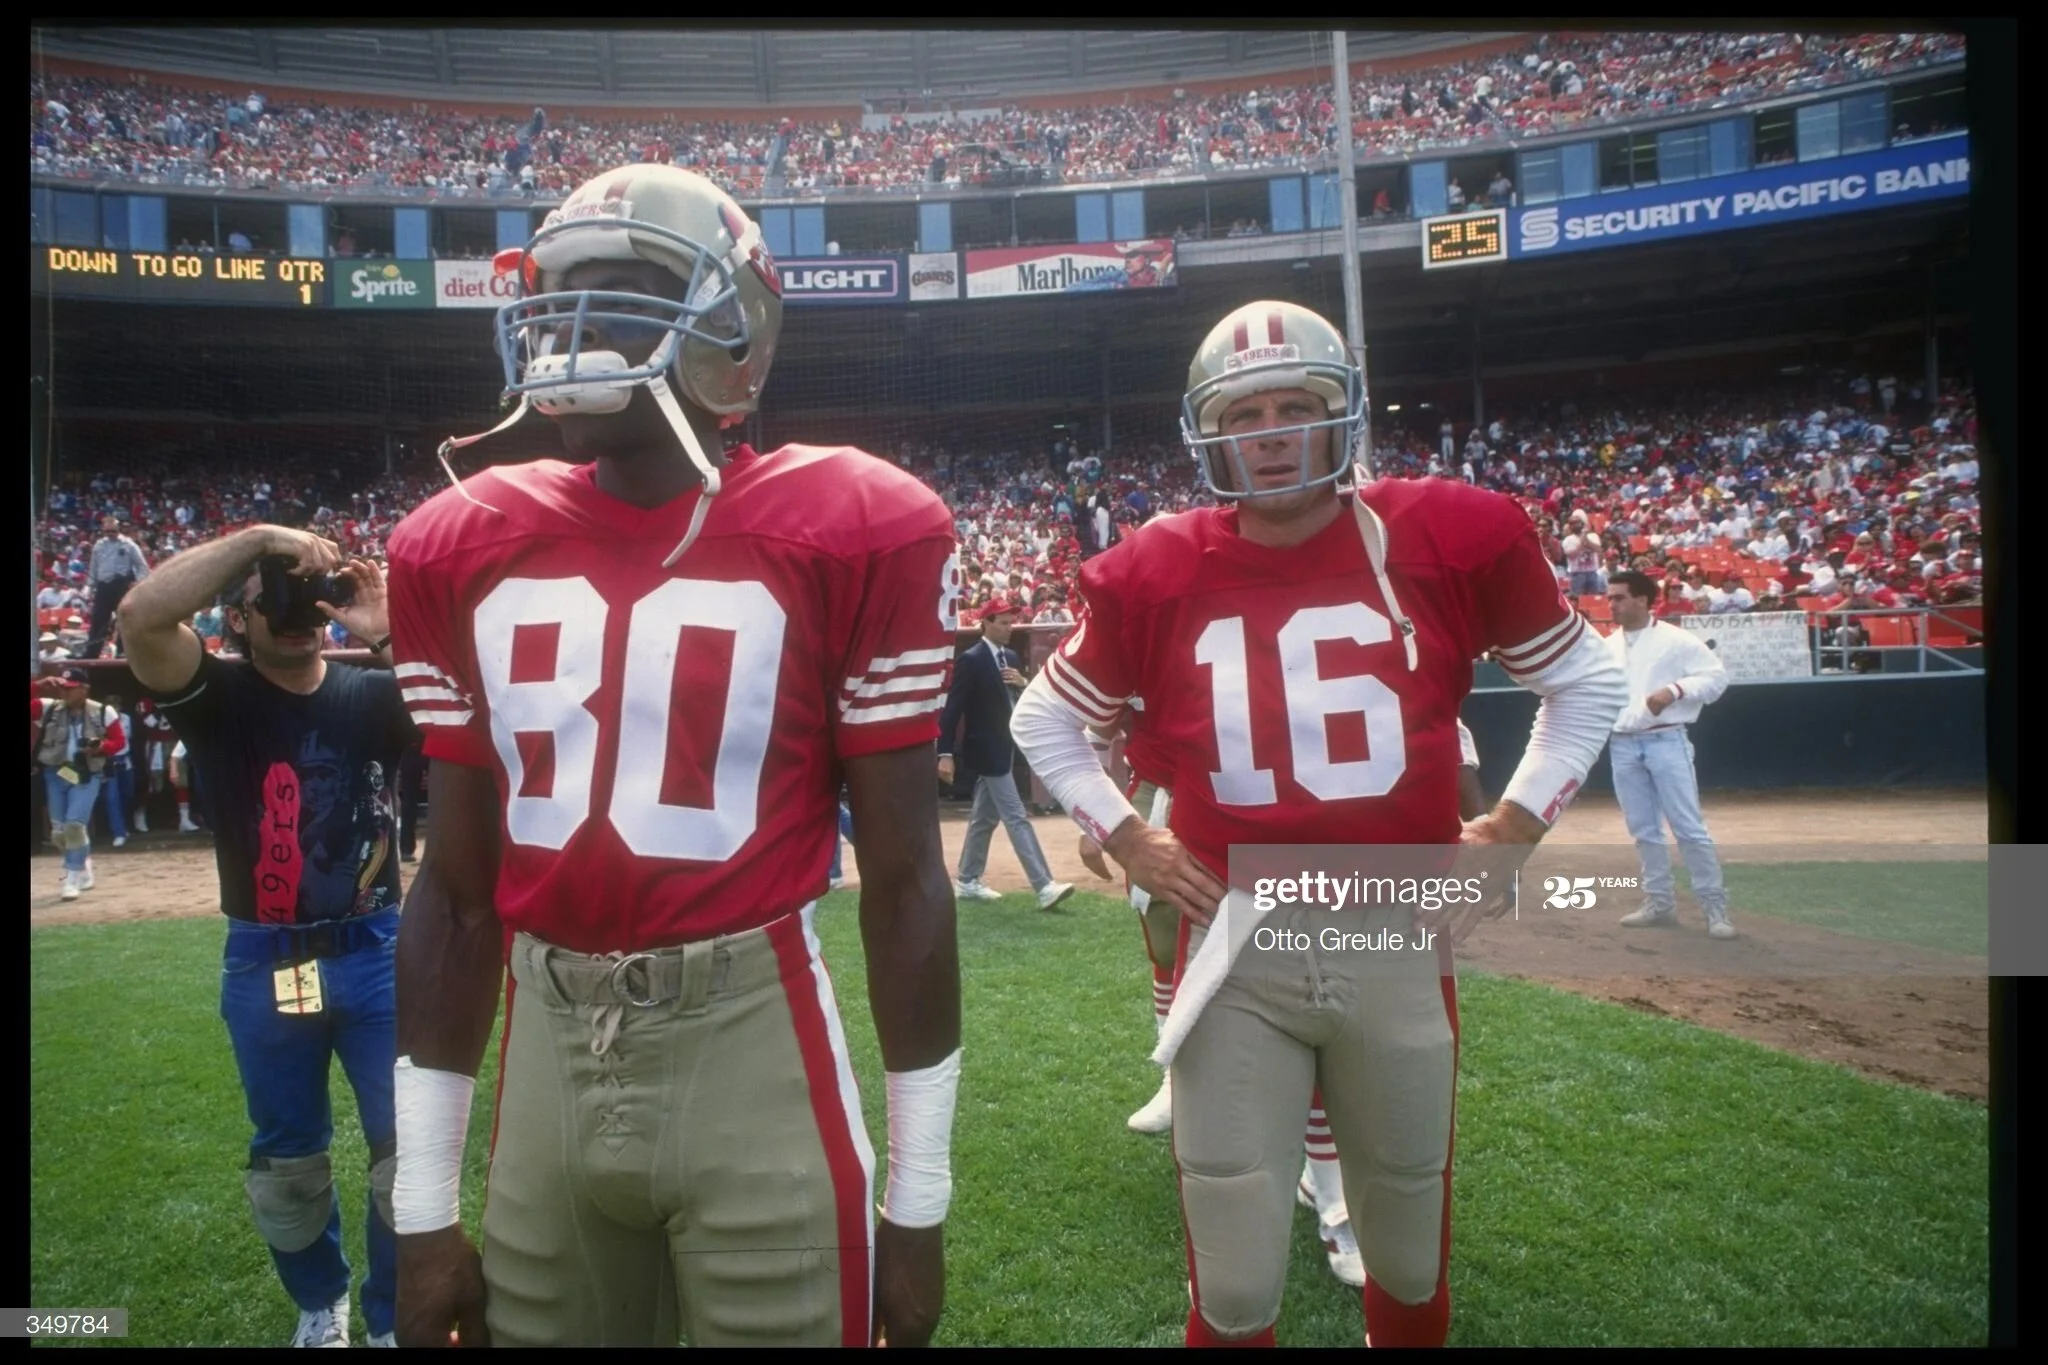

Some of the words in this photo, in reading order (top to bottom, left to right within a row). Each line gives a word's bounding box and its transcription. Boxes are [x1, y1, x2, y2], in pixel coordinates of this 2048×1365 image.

[1565, 196, 1725, 240] SECURITY
[1733, 175, 1867, 216] PACIFIC
[1431, 217, 1498, 260] 25
[50, 248, 117, 274] DOWN
[132, 254, 167, 276] TO
[172, 256, 202, 278] GO
[216, 257, 265, 280] LINE
[279, 260, 325, 282] QTR
[783, 270, 888, 289] LIGHT
[300, 284, 312, 305] 1
[351, 269, 417, 302] Sprite
[444, 278, 486, 298] diet
[1242, 347, 1279, 362] 49ERS
[474, 576, 787, 861] 80
[1195, 602, 1406, 806] 16
[261, 782, 297, 924] 49ers
